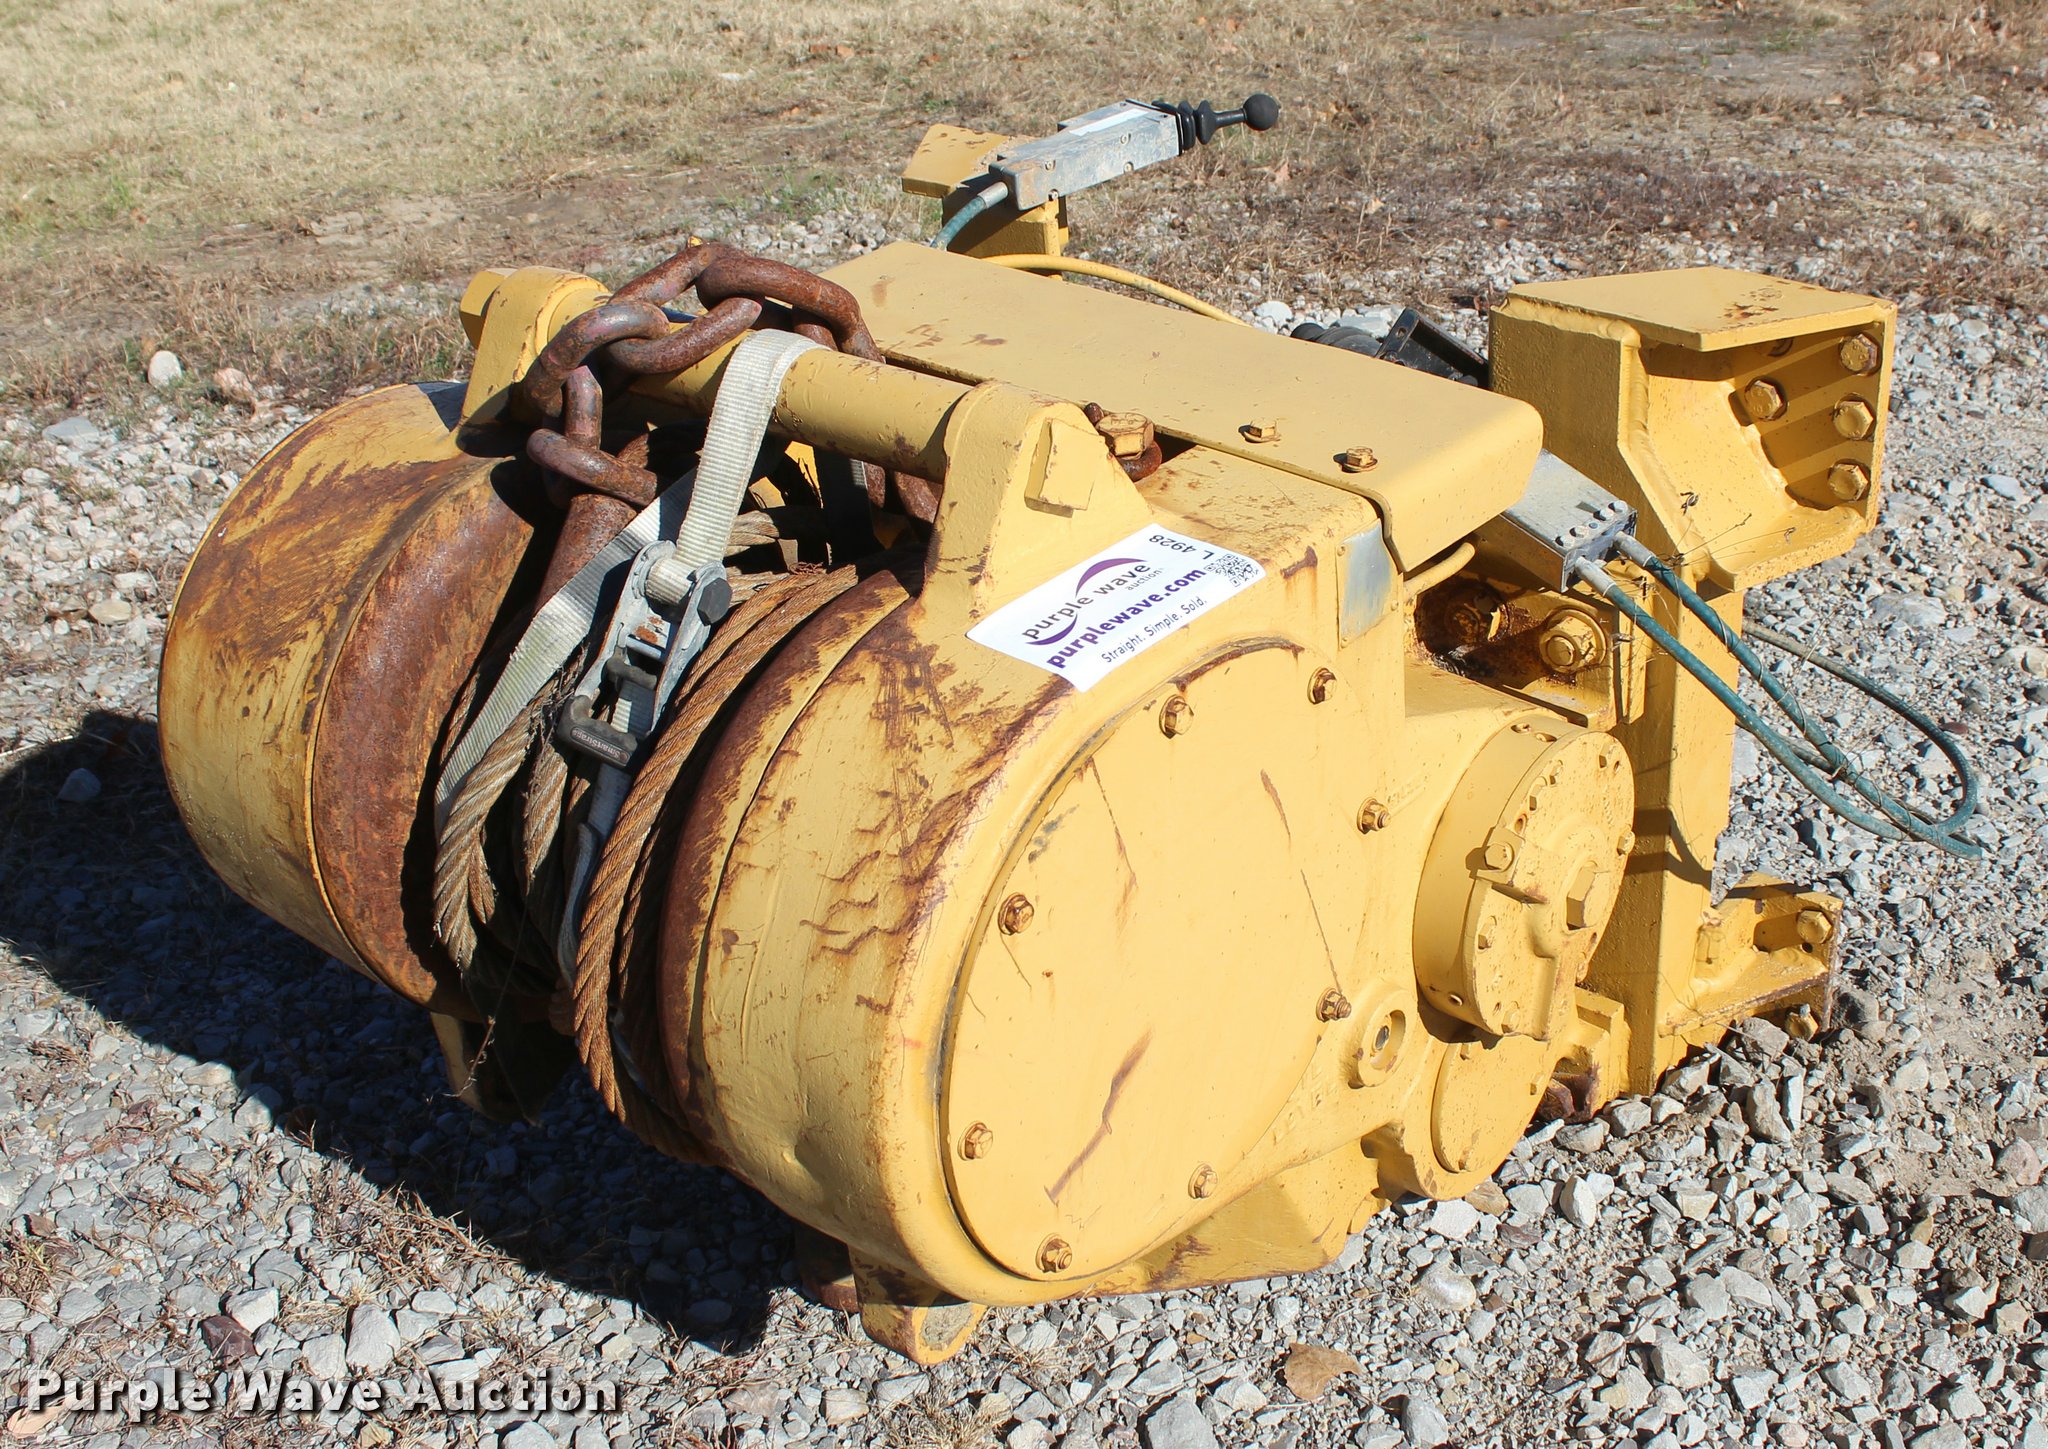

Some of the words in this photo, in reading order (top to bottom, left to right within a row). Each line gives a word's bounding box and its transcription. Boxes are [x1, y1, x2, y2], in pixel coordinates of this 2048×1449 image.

[1149, 534, 1197, 553] 4928
[1202, 550, 1214, 560] L
[1126, 568, 1162, 591] auction
[1021, 595, 1094, 640] purple
[1094, 563, 1151, 595] wave
[1046, 568, 1207, 669] purplewave.com
[1101, 631, 1146, 663] Straight.
[1143, 611, 1183, 637] Simple.
[1180, 596, 1208, 615] Sold.
[572, 729, 622, 760] SmartStraps
